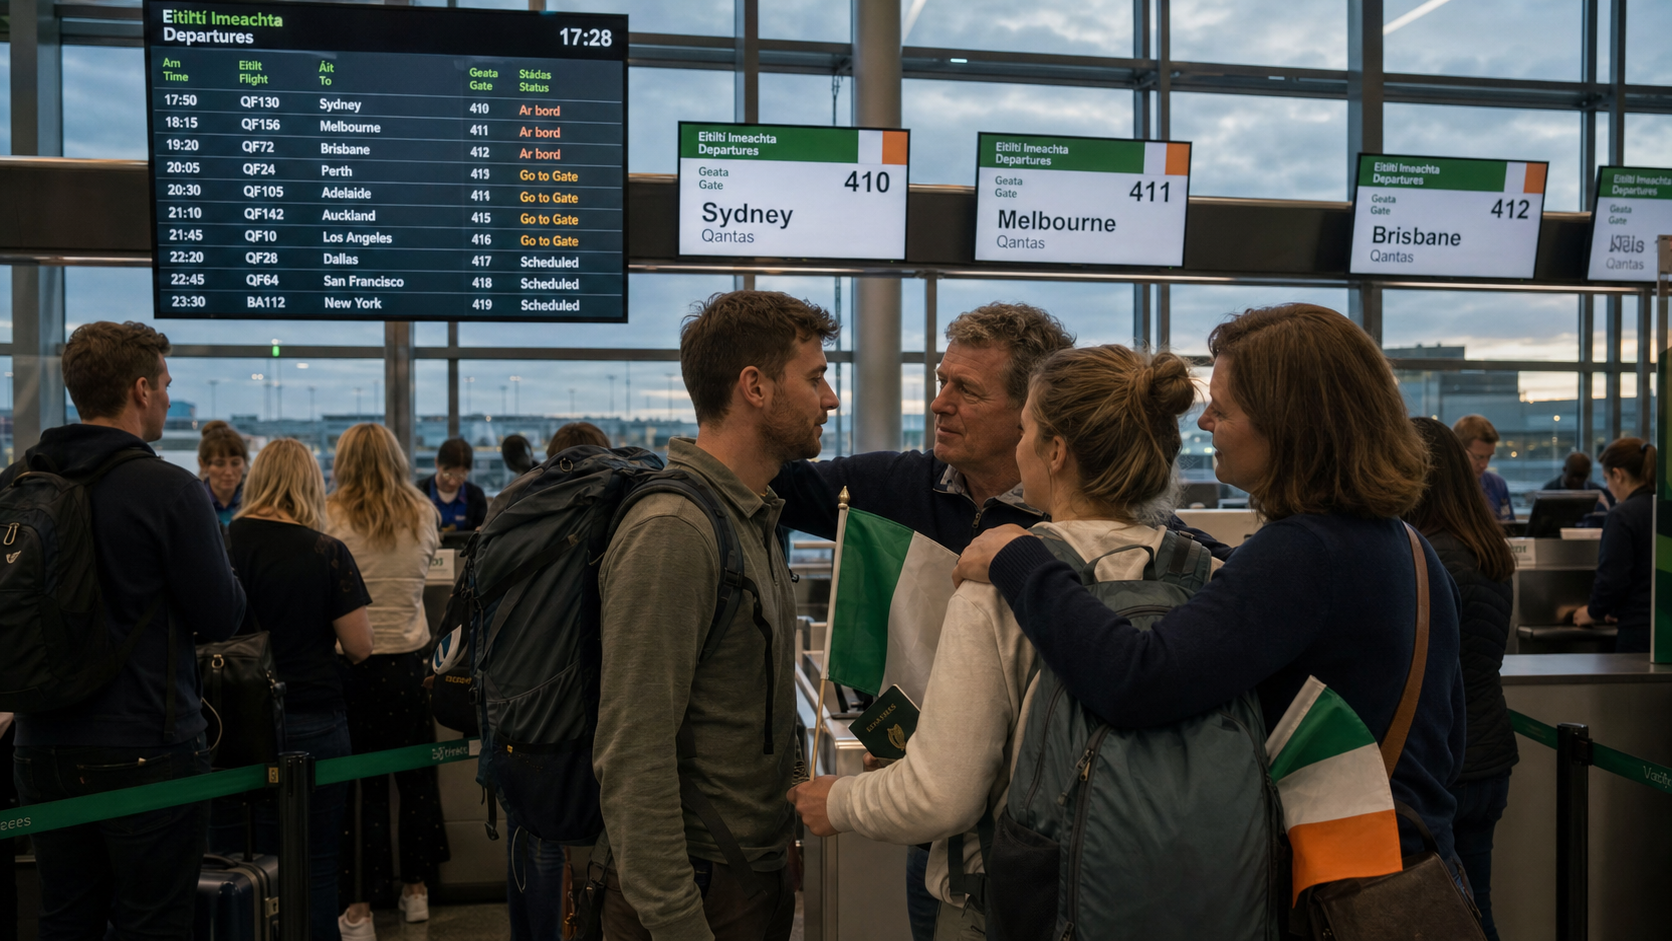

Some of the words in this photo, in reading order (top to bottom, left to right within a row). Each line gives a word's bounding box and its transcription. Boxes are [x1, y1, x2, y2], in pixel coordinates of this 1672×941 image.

[211, 12, 282, 27] Imeachta
[163, 27, 253, 45] Departures
[559, 28, 612, 46] 17:28
[162, 58, 180, 67] Am
[318, 61, 334, 72] Áit
[469, 68, 498, 77] Geata
[519, 69, 551, 79] Stádas
[162, 72, 188, 81] Time
[239, 74, 268, 85] Flight
[318, 76, 331, 85] To
[469, 81, 492, 90] Gate
[519, 82, 549, 92] Status
[164, 94, 197, 105] 17:50
[240, 96, 279, 108] QF130
[319, 98, 361, 113] Sydney
[469, 103, 489, 114] 410
[519, 105, 532, 115] Ar
[535, 105, 560, 116] bord
[165, 117, 198, 128] 18:15
[241, 118, 280, 131] QF156
[320, 121, 380, 132] Melbourne
[469, 125, 487, 135] 411
[519, 127, 532, 137] Ar
[535, 127, 560, 137] bord
[728, 133, 776, 143] Imeachta
[166, 139, 198, 150] 19:20
[241, 141, 274, 153] QF72
[320, 143, 370, 155] Brisbane
[469, 147, 489, 157] 412
[519, 148, 532, 158] Ar
[535, 148, 560, 159] bord
[698, 144, 758, 156] Departures
[1023, 143, 1068, 154] Imeachta
[995, 154, 1051, 166] Departures
[166, 162, 200, 173] 20:05
[242, 163, 275, 175] QF24
[321, 165, 352, 176] Perth
[519, 170, 535, 180] Go
[537, 172, 549, 181] to
[552, 171, 578, 181] Gate
[698, 167, 728, 176] Geata
[1399, 164, 1440, 174] Imeachta
[698, 180, 723, 190] Gate
[844, 171, 889, 193] 410
[994, 176, 1022, 185] Geata
[1372, 174, 1423, 185] Departures
[167, 184, 201, 195] 20:30
[243, 186, 283, 197] QF105
[321, 187, 371, 199] Adelaide
[519, 192, 535, 202] Go
[538, 193, 549, 202] to
[552, 193, 578, 203] Gate
[994, 188, 1017, 198] Gate
[1129, 181, 1169, 202] 411
[1611, 185, 1658, 196] Departures
[1371, 194, 1396, 203] Geata
[168, 207, 201, 218] 21:10
[243, 208, 283, 220] QF142
[321, 210, 375, 221] Auckland
[471, 212, 491, 223] 415
[520, 213, 536, 224] Go
[538, 215, 549, 224] to
[552, 214, 578, 225] Gate
[701, 202, 793, 228] Sydney
[1370, 206, 1390, 214] Gate
[1490, 199, 1529, 219] 412
[1609, 205, 1632, 213] Geata
[998, 210, 1116, 232] Melbourne
[1608, 216, 1627, 224] Gate
[169, 229, 203, 240] 21:45
[244, 230, 276, 242] QF10
[323, 232, 343, 242] Los
[345, 232, 392, 245] Angeles
[471, 234, 491, 245] 416
[520, 235, 536, 245] Go
[538, 237, 550, 246] to
[552, 236, 578, 246] Gate
[701, 229, 754, 243] Qantas
[996, 235, 1044, 249] Qantas
[1372, 226, 1461, 246] Brisbane
[169, 251, 203, 262] 22:20
[245, 252, 278, 264] QF28
[323, 253, 358, 264] Dallas
[471, 256, 491, 266] 417
[520, 256, 578, 268] Scheduled
[1370, 250, 1413, 262] Qantas
[1605, 259, 1644, 270] Qantas
[170, 274, 204, 285] 22:45
[245, 274, 279, 286] QF64
[324, 275, 345, 286] San
[348, 276, 404, 287] Francisco
[471, 277, 492, 288] 418
[520, 278, 579, 289] Scheduled
[171, 296, 205, 307] 23:30
[246, 297, 285, 307] BA112
[324, 297, 351, 309] New
[352, 297, 382, 308] York
[472, 299, 492, 310] 419
[520, 299, 579, 311] Scheduled
